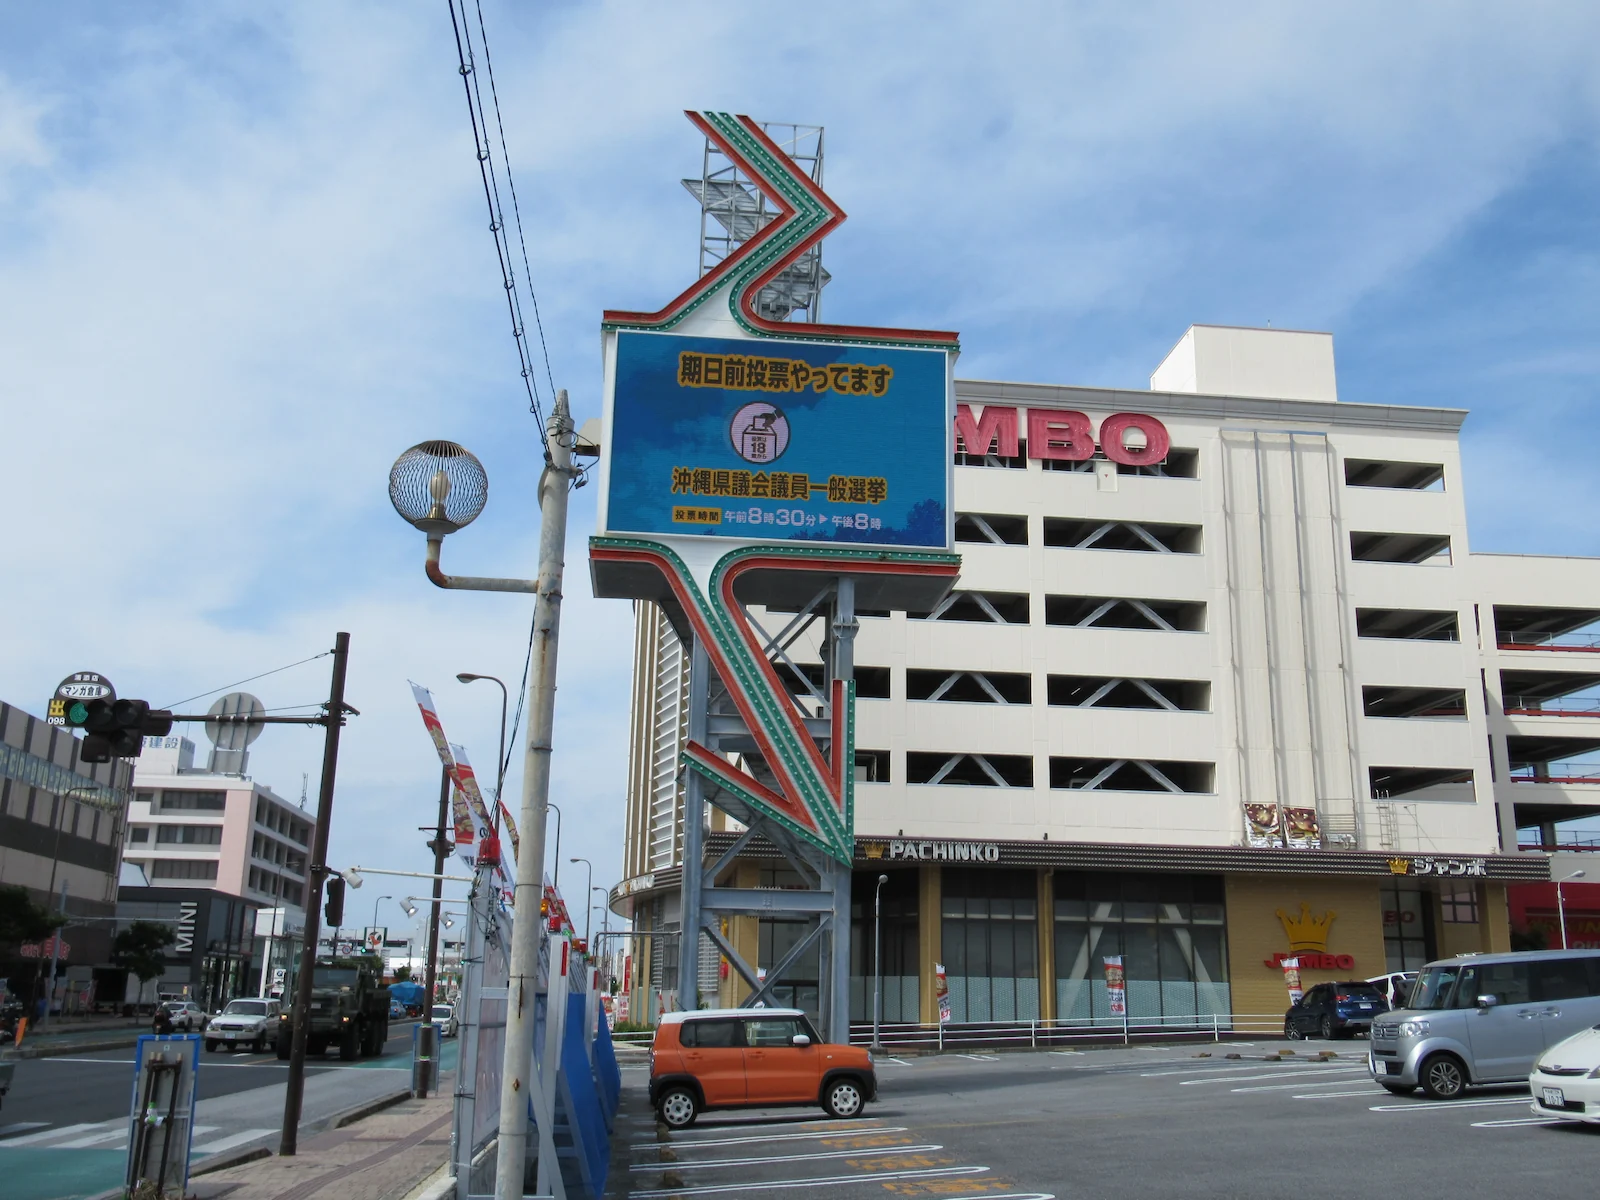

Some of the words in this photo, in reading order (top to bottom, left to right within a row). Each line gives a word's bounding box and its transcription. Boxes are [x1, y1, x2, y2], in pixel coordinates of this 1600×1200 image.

[681, 355, 890, 394] 期日前投票やってます
[751, 442, 767, 454] 18
[672, 468, 886, 503] 沖縄県議会議員一般選挙
[675, 509, 719, 522] 投票時間
[65, 686, 103, 697] マンガ倉庫
[47, 716, 66, 726] 098
[890, 843, 1000, 862] PACHINKO
[1413, 857, 1488, 876] ジャンボ
[175, 901, 198, 952] MINI
[1264, 952, 1355, 970] JMBO
